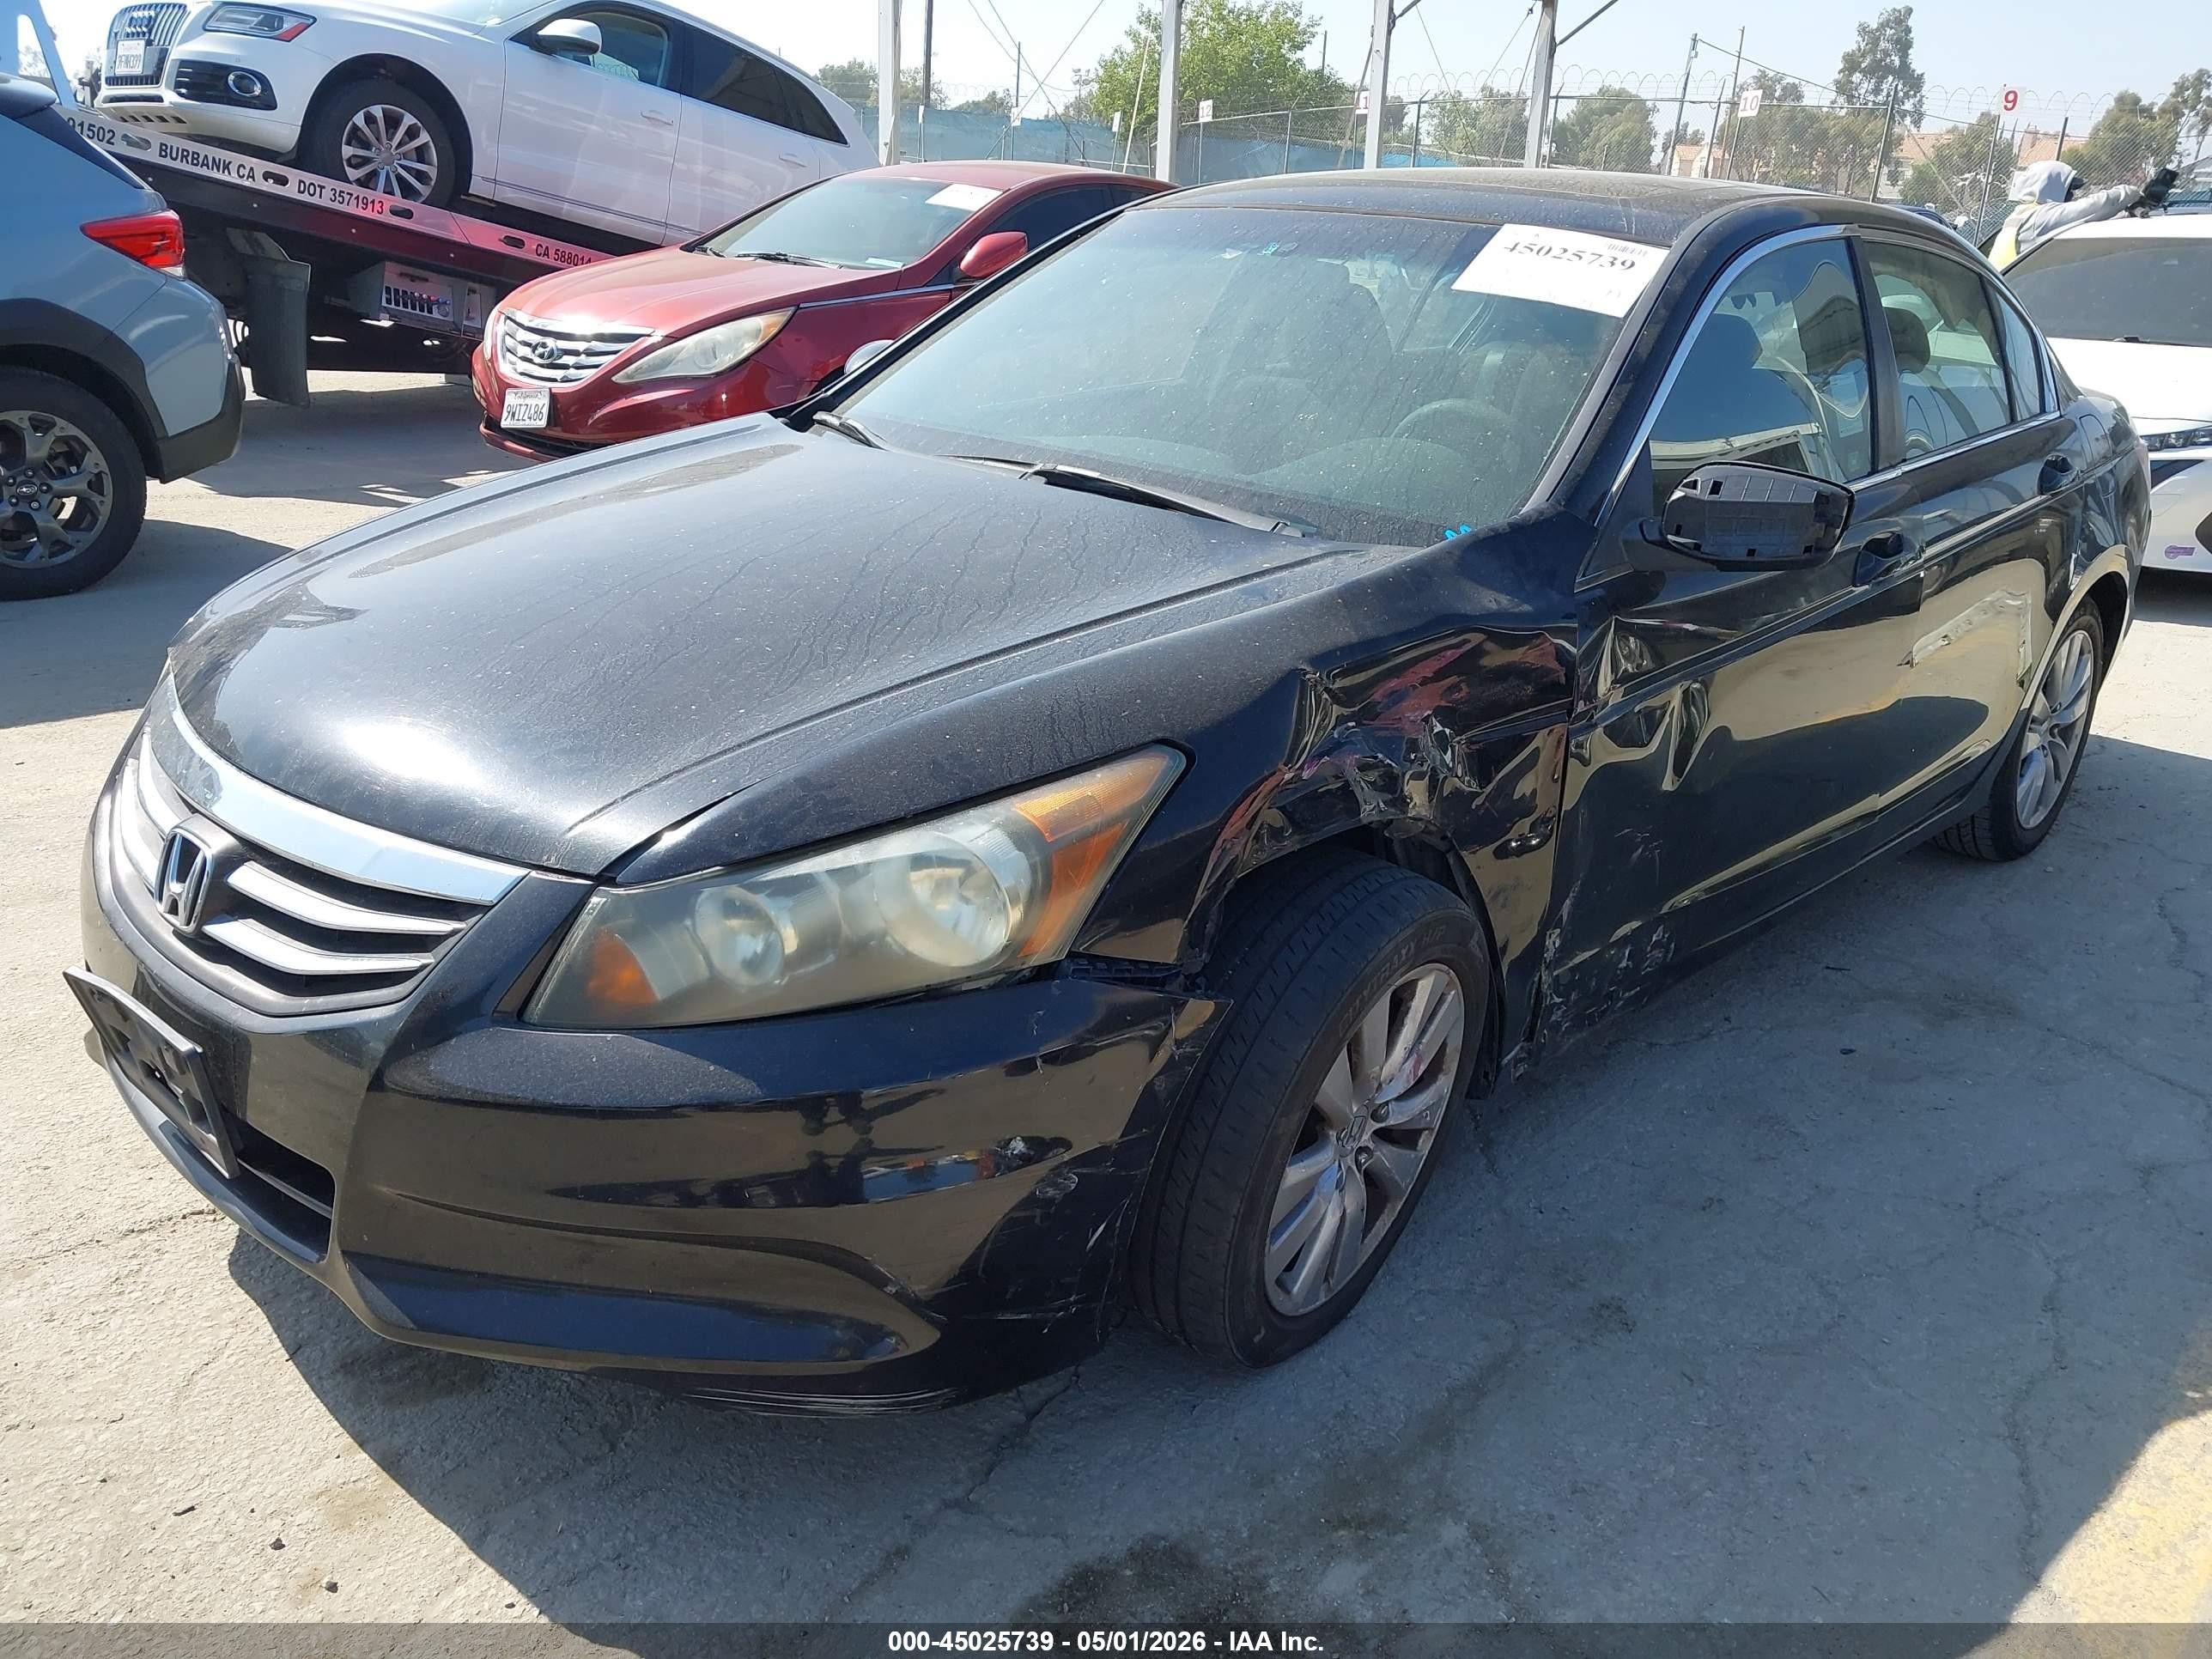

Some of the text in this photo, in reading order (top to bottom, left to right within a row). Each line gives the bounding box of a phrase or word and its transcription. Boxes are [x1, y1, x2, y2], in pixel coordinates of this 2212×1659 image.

[1200, 104, 1212, 118] 12
[1740, 94, 1759, 112] 10
[2003, 89, 2019, 112] 9
[158, 142, 233, 176] BURBANK
[236, 163, 256, 182] CA
[297, 179, 384, 215] DOT 3571913
[535, 243, 550, 259] CA
[1504, 241, 1636, 270] 45025739
